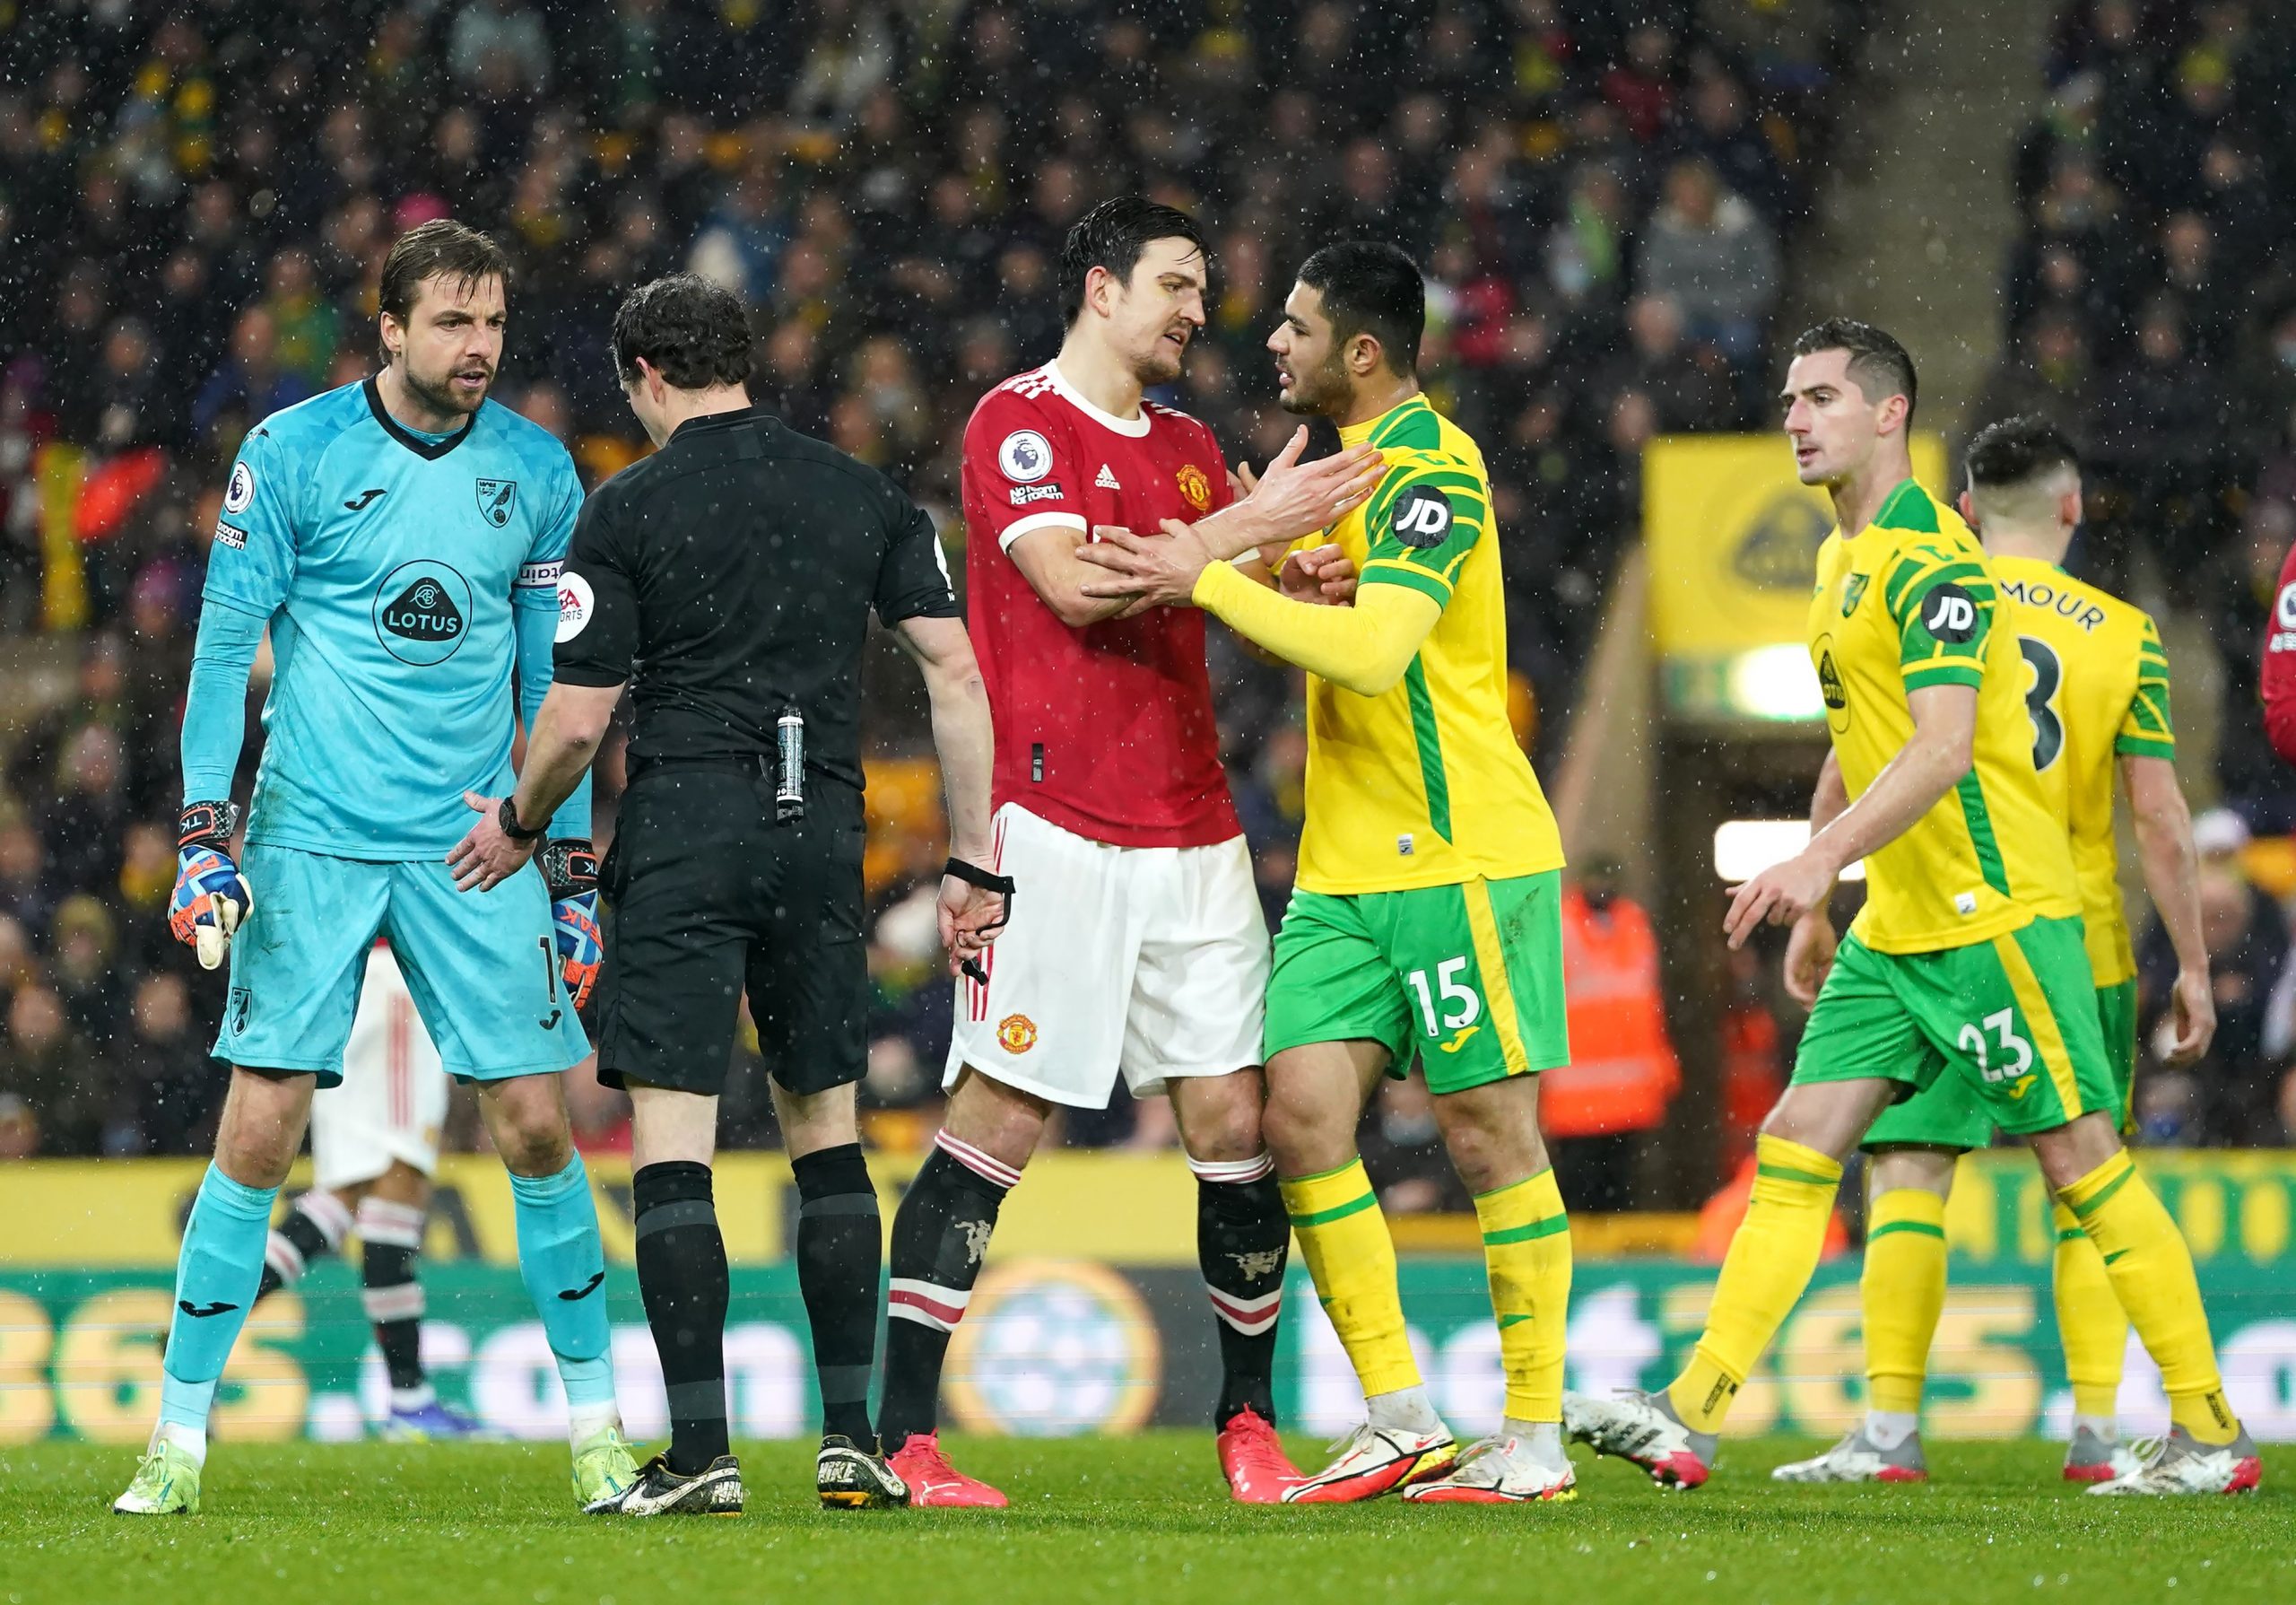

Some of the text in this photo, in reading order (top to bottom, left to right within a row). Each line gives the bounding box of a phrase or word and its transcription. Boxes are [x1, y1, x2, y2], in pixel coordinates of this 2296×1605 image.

[1094, 479, 1121, 492] adidas
[1396, 498, 1448, 534] JD
[388, 610, 457, 633] LOTUS
[560, 609, 583, 623] ORTS
[1928, 596, 1973, 631] JD
[2001, 581, 2104, 632] MOUR
[181, 815, 203, 834] TK
[539, 936, 557, 1005] 1
[1408, 955, 1481, 1037] 15
[1958, 1006, 2033, 1083] 23
